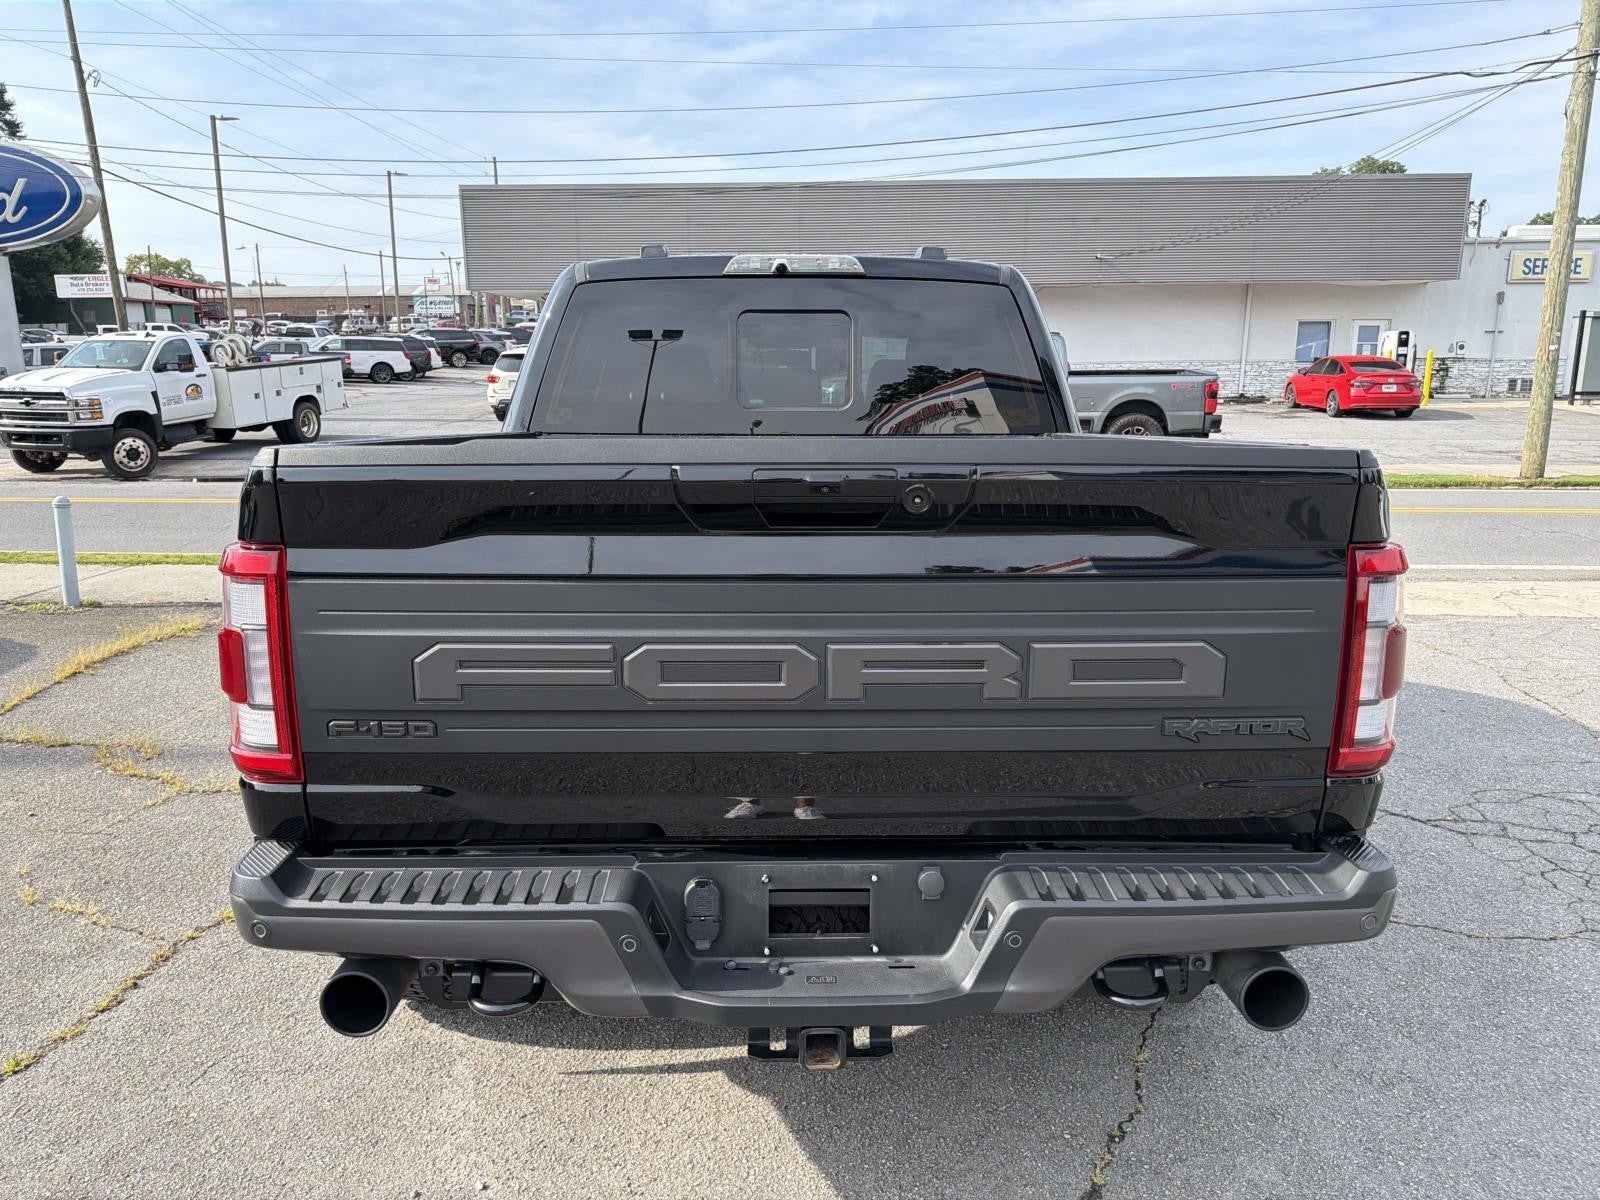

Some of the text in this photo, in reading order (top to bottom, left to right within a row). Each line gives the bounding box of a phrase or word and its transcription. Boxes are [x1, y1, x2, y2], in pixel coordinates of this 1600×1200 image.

[1522, 257, 1583, 275] SERE
[413, 642, 1227, 702] FORD
[1161, 716, 1311, 743] RAPTOR
